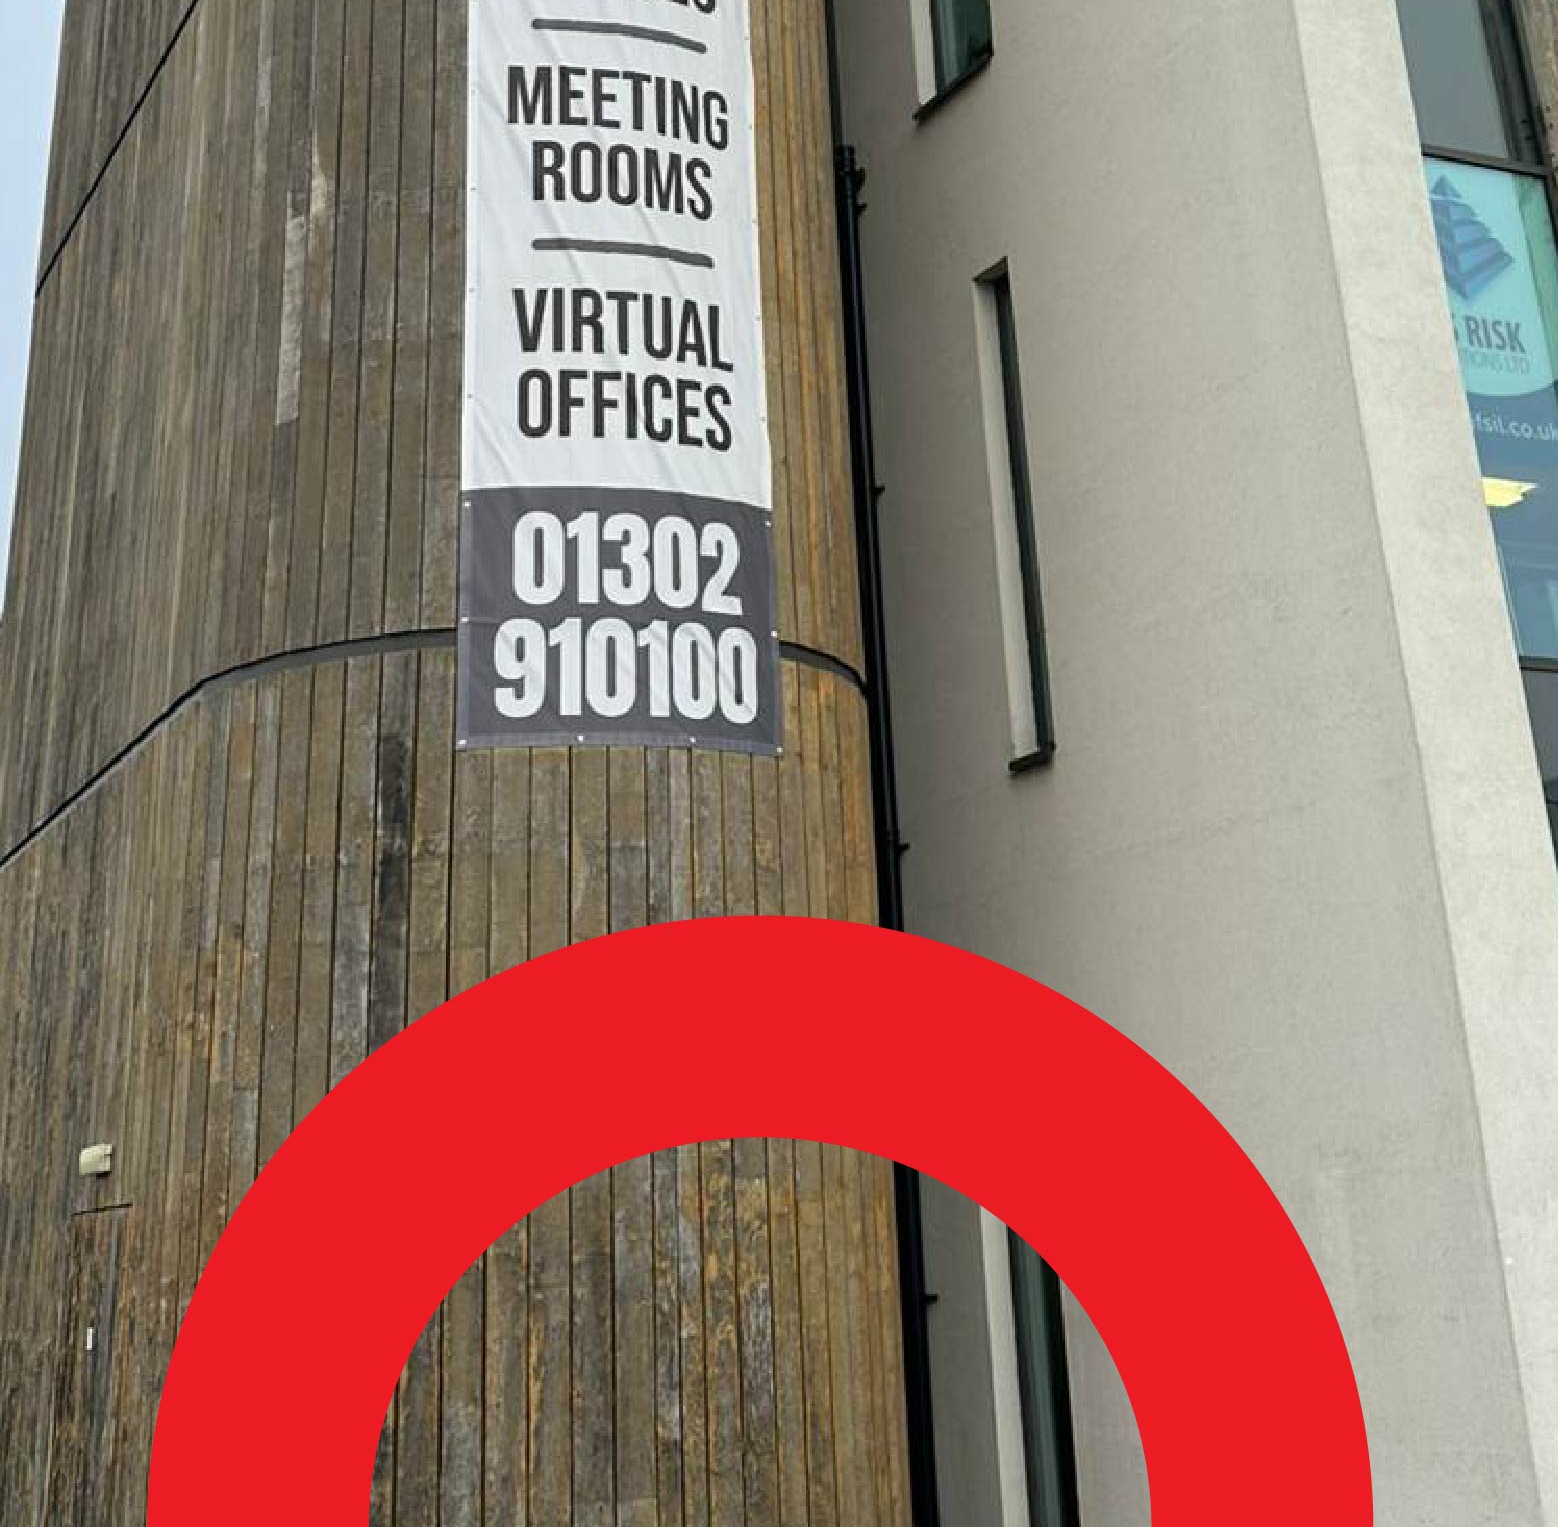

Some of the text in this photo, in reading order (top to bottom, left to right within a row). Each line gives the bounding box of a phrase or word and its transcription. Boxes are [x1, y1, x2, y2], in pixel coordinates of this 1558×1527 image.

[506, 65, 728, 150] MEETING
[531, 140, 713, 221] ROOMS
[512, 288, 734, 372] VIRTUAL
[1464, 315, 1527, 354] RISK
[517, 367, 732, 452] OFFICES
[512, 511, 743, 615] 01302
[493, 618, 758, 725] 910100
